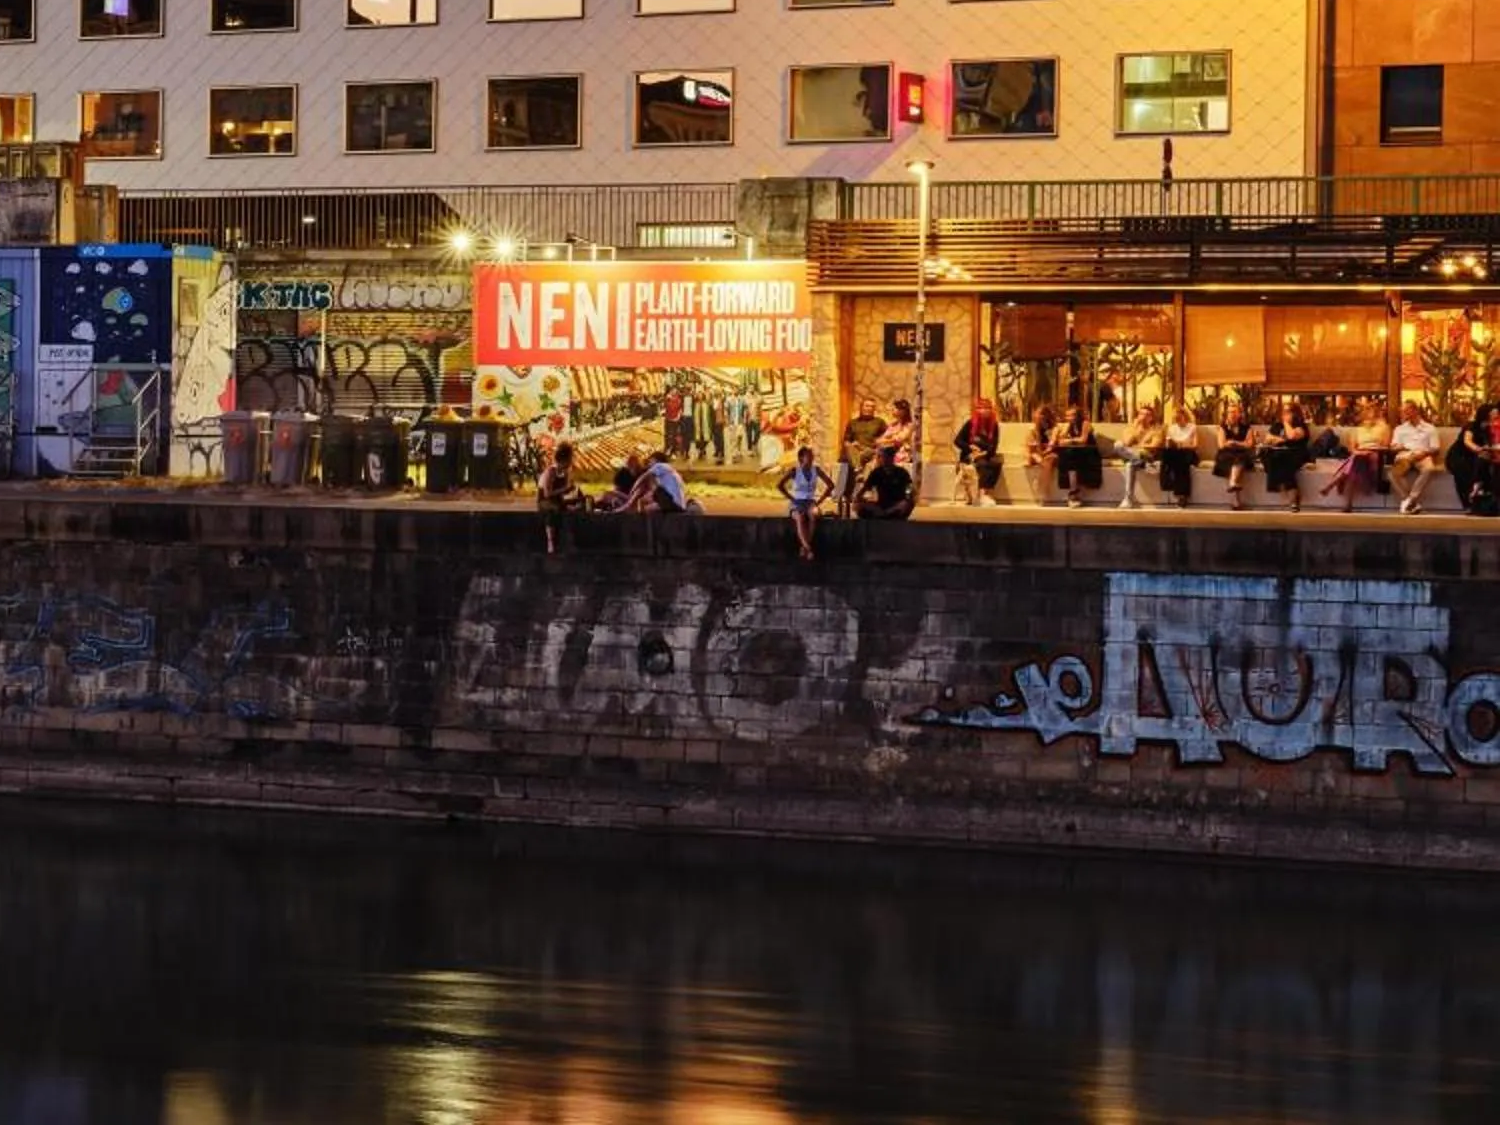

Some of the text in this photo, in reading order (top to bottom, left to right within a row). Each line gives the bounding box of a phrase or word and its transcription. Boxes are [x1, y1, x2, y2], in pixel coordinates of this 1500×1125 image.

[634, 281, 796, 314] PLANT-FORWARD
[498, 281, 630, 350] NENI
[634, 318, 773, 352] EARTH-LOVING
[896, 329, 931, 347] NEI
